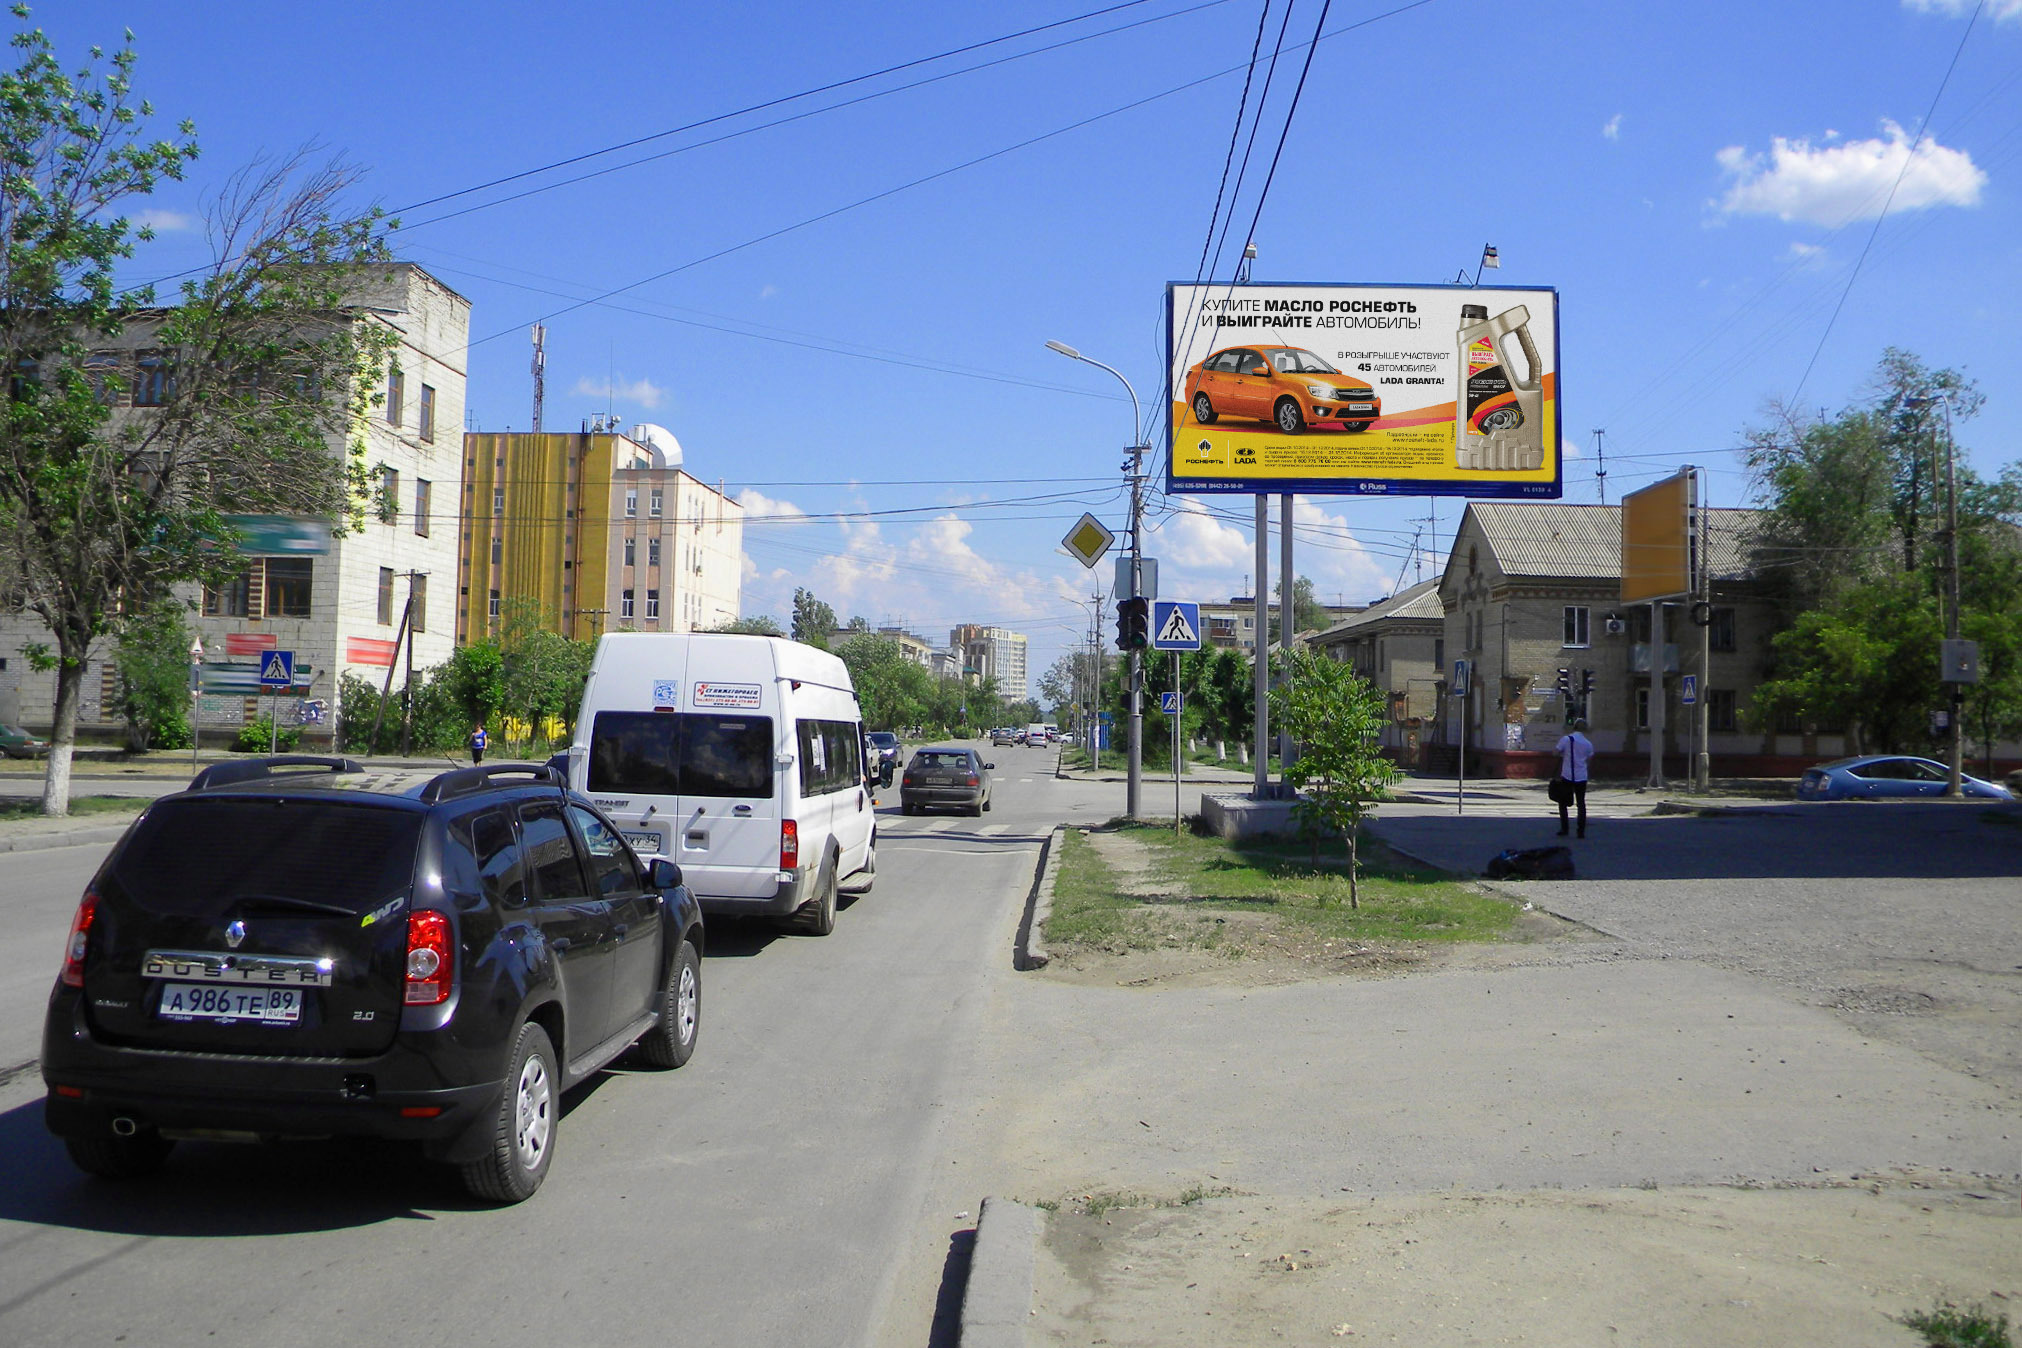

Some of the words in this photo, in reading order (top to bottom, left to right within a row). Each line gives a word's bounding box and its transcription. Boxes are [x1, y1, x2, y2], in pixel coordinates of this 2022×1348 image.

[1202, 299, 1260, 311] КУПИТЕ
[1264, 300, 1324, 312] МАСЛО
[1329, 300, 1417, 313] РОСНЕФТЬ
[1202, 315, 1213, 326] И
[1216, 313, 1312, 328] ВЫИГРАЙТЕ
[1316, 316, 1421, 329] АВТОМОБИЛЬ!
[1345, 352, 1399, 360] РОЗЫГРЫШЕ
[1401, 352, 1450, 360] УЧАСТВУЮТ
[1358, 363, 1372, 372] 45
[1374, 363, 1437, 373] АВТОМОБИЛЕЙ
[1380, 377, 1404, 385] LADA
[1405, 377, 1445, 385] GRANTA!
[147, 963, 319, 983] DUSTER
[270, 990, 294, 1010] 89
[267, 1009, 285, 1018] RUS
[353, 1011, 375, 1021] 2.0
